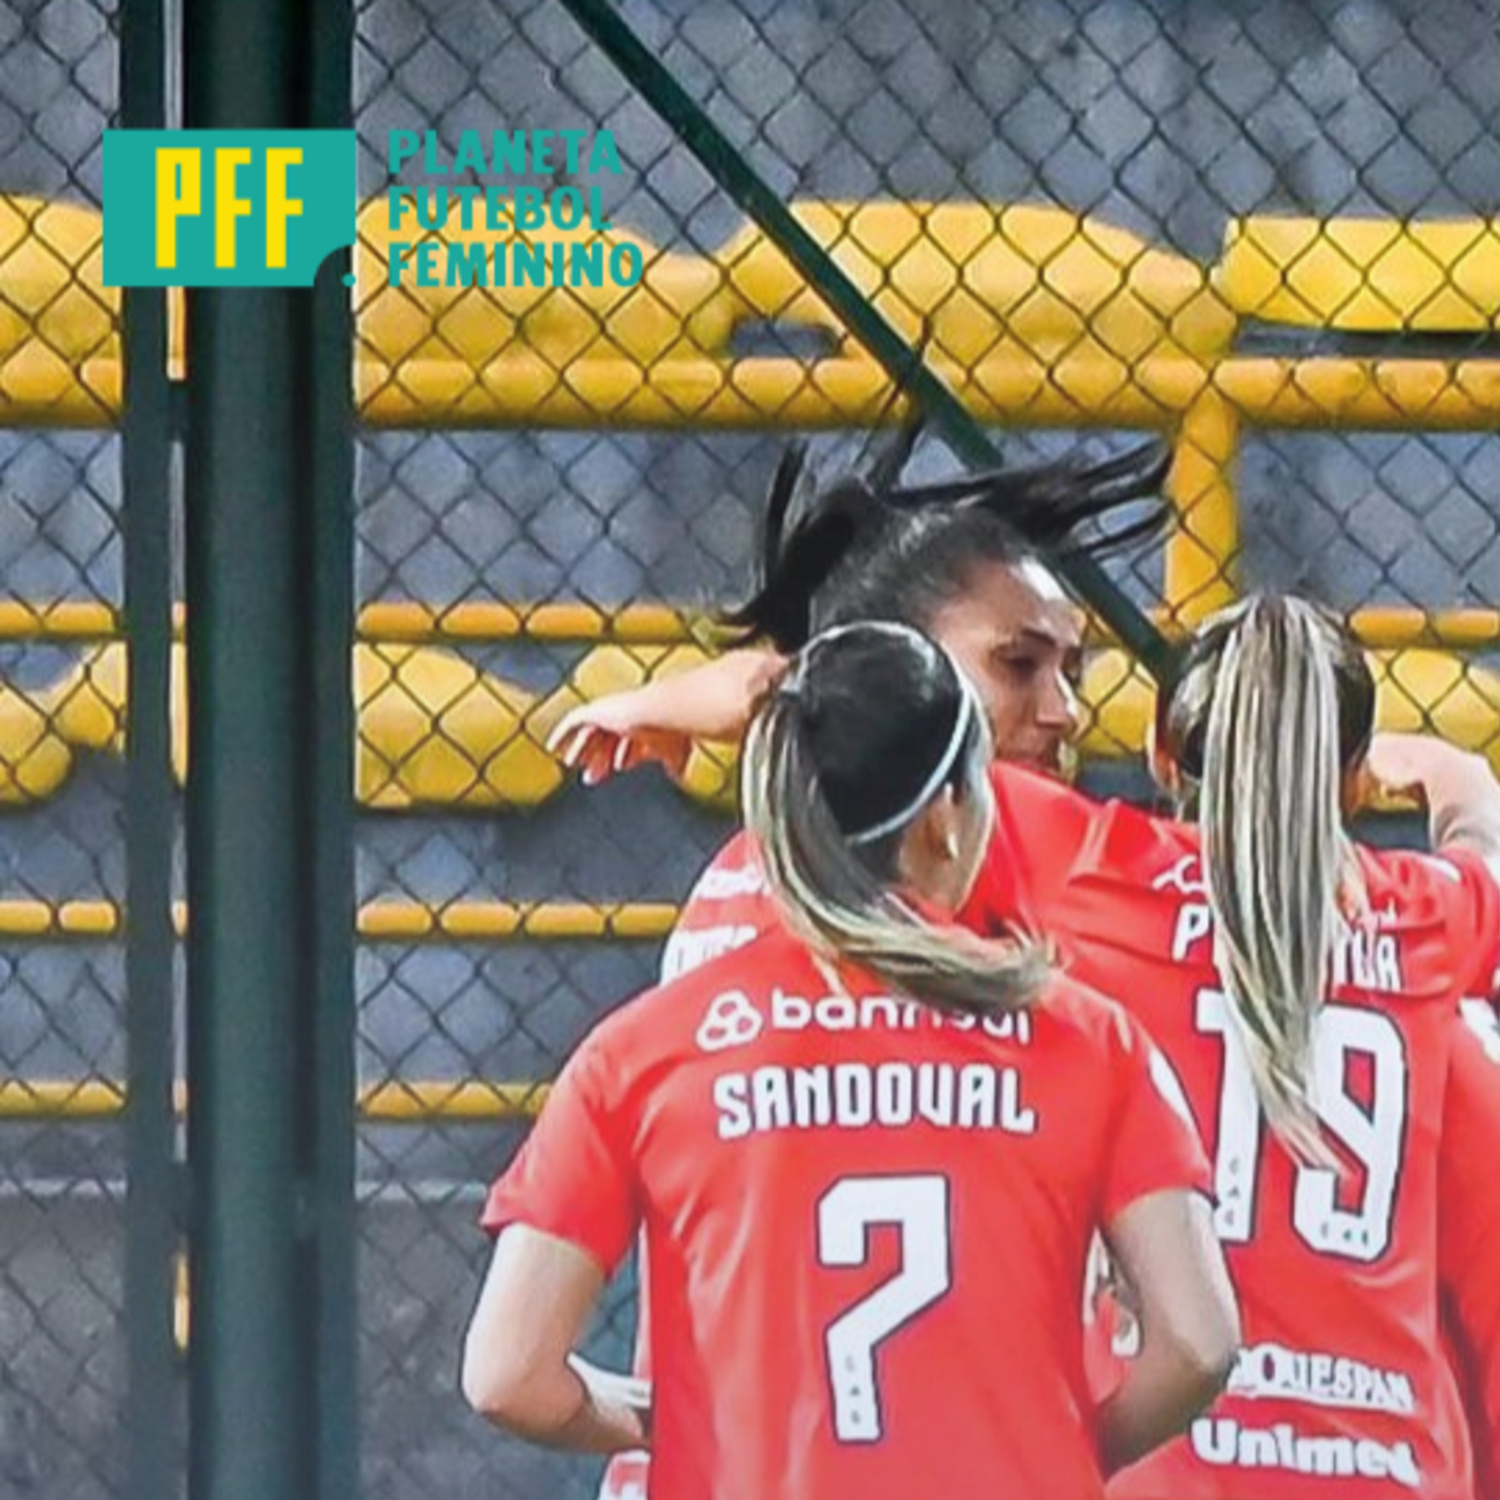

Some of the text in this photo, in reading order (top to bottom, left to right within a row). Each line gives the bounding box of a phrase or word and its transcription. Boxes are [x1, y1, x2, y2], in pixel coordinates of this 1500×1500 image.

[712, 1061, 1036, 1140] SANDOVAL
[816, 1174, 952, 1443] 7
[1191, 1416, 1423, 1487] Unimed
